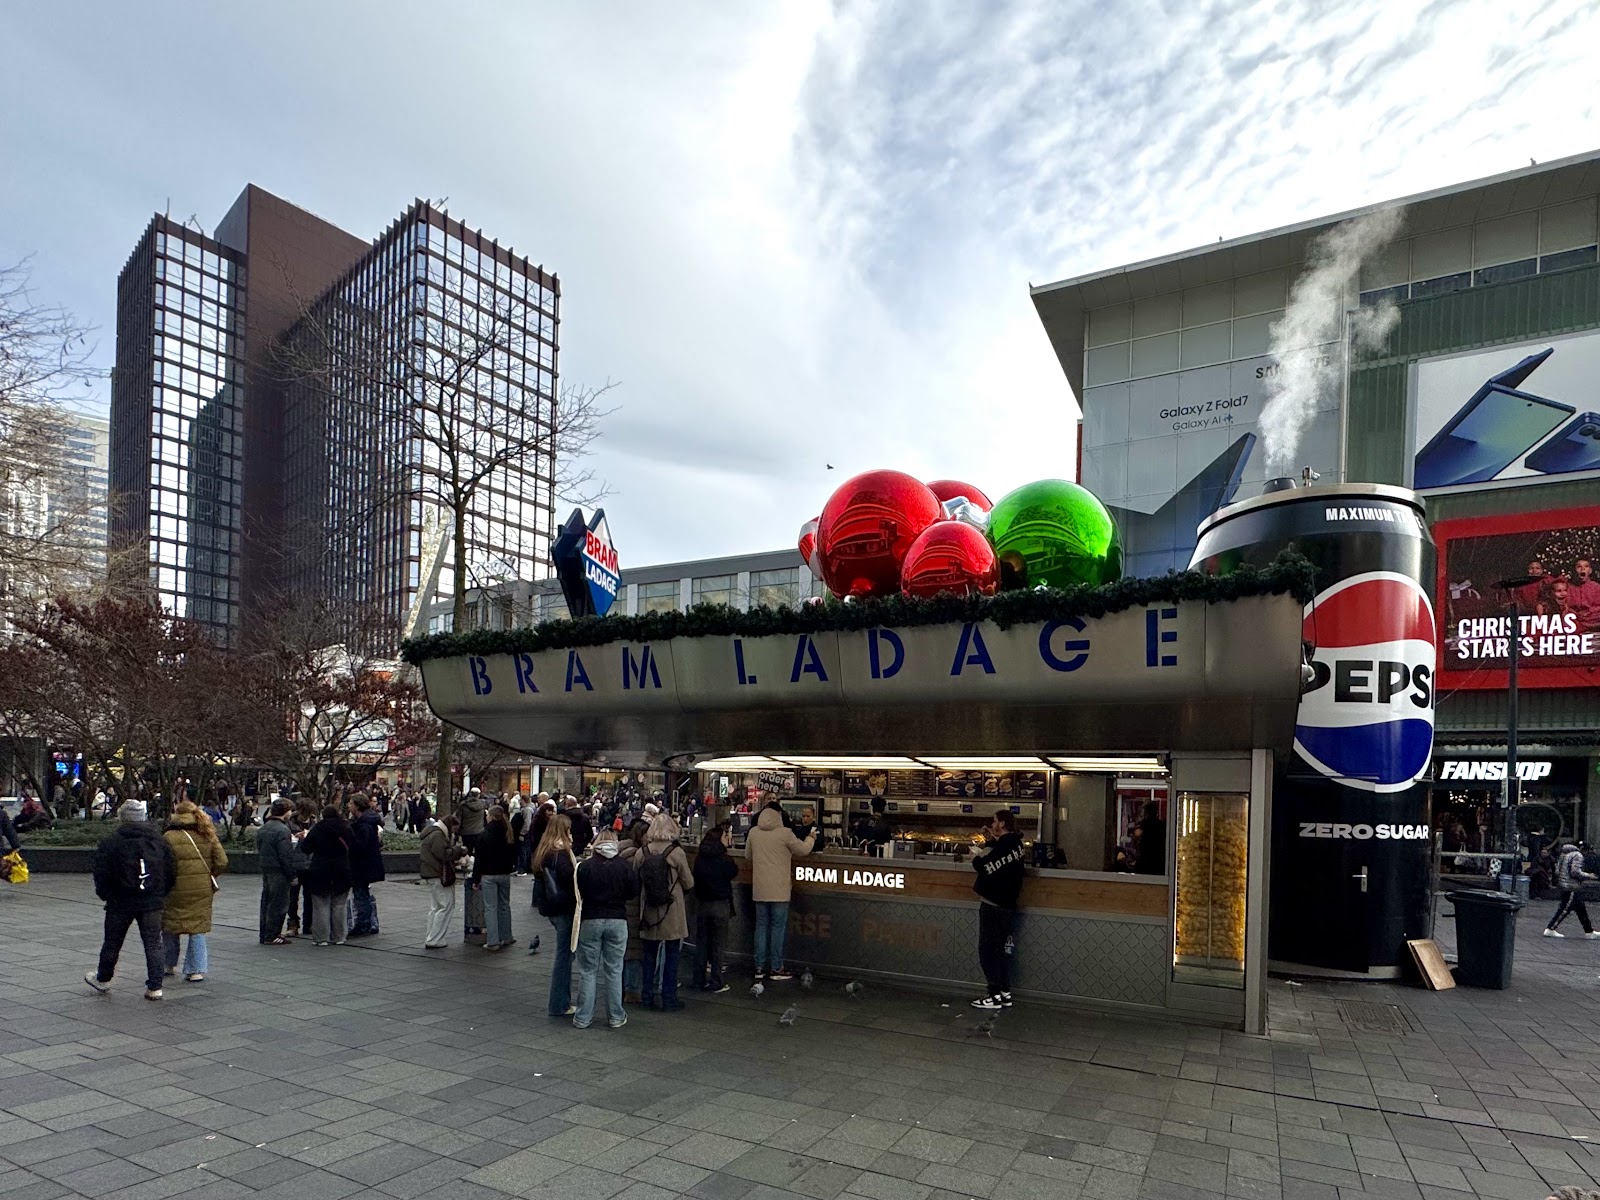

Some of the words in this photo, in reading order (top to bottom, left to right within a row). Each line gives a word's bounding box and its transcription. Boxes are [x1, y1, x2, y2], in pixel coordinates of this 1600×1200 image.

[1160, 403, 1202, 418] Galaxy
[1206, 401, 1212, 412] Z
[1215, 395, 1249, 410] Fold7
[1172, 417, 1210, 431] Galaxy
[1211, 416, 1221, 425] AI
[1325, 507, 1395, 522] MAXIMUM
[587, 532, 618, 575] BRAM
[586, 560, 617, 597] LADAGE
[469, 645, 663, 696] BRAM
[734, 608, 1178, 685] LADAGE
[1457, 637, 1535, 659] STARS
[1539, 634, 1594, 656] HERE
[757, 778, 779, 793] here
[759, 771, 785, 785] order
[1299, 822, 1374, 839] ZERO
[1375, 824, 1429, 840] SUGAR
[795, 866, 838, 883] BRAM
[843, 870, 905, 889] LADAGE
